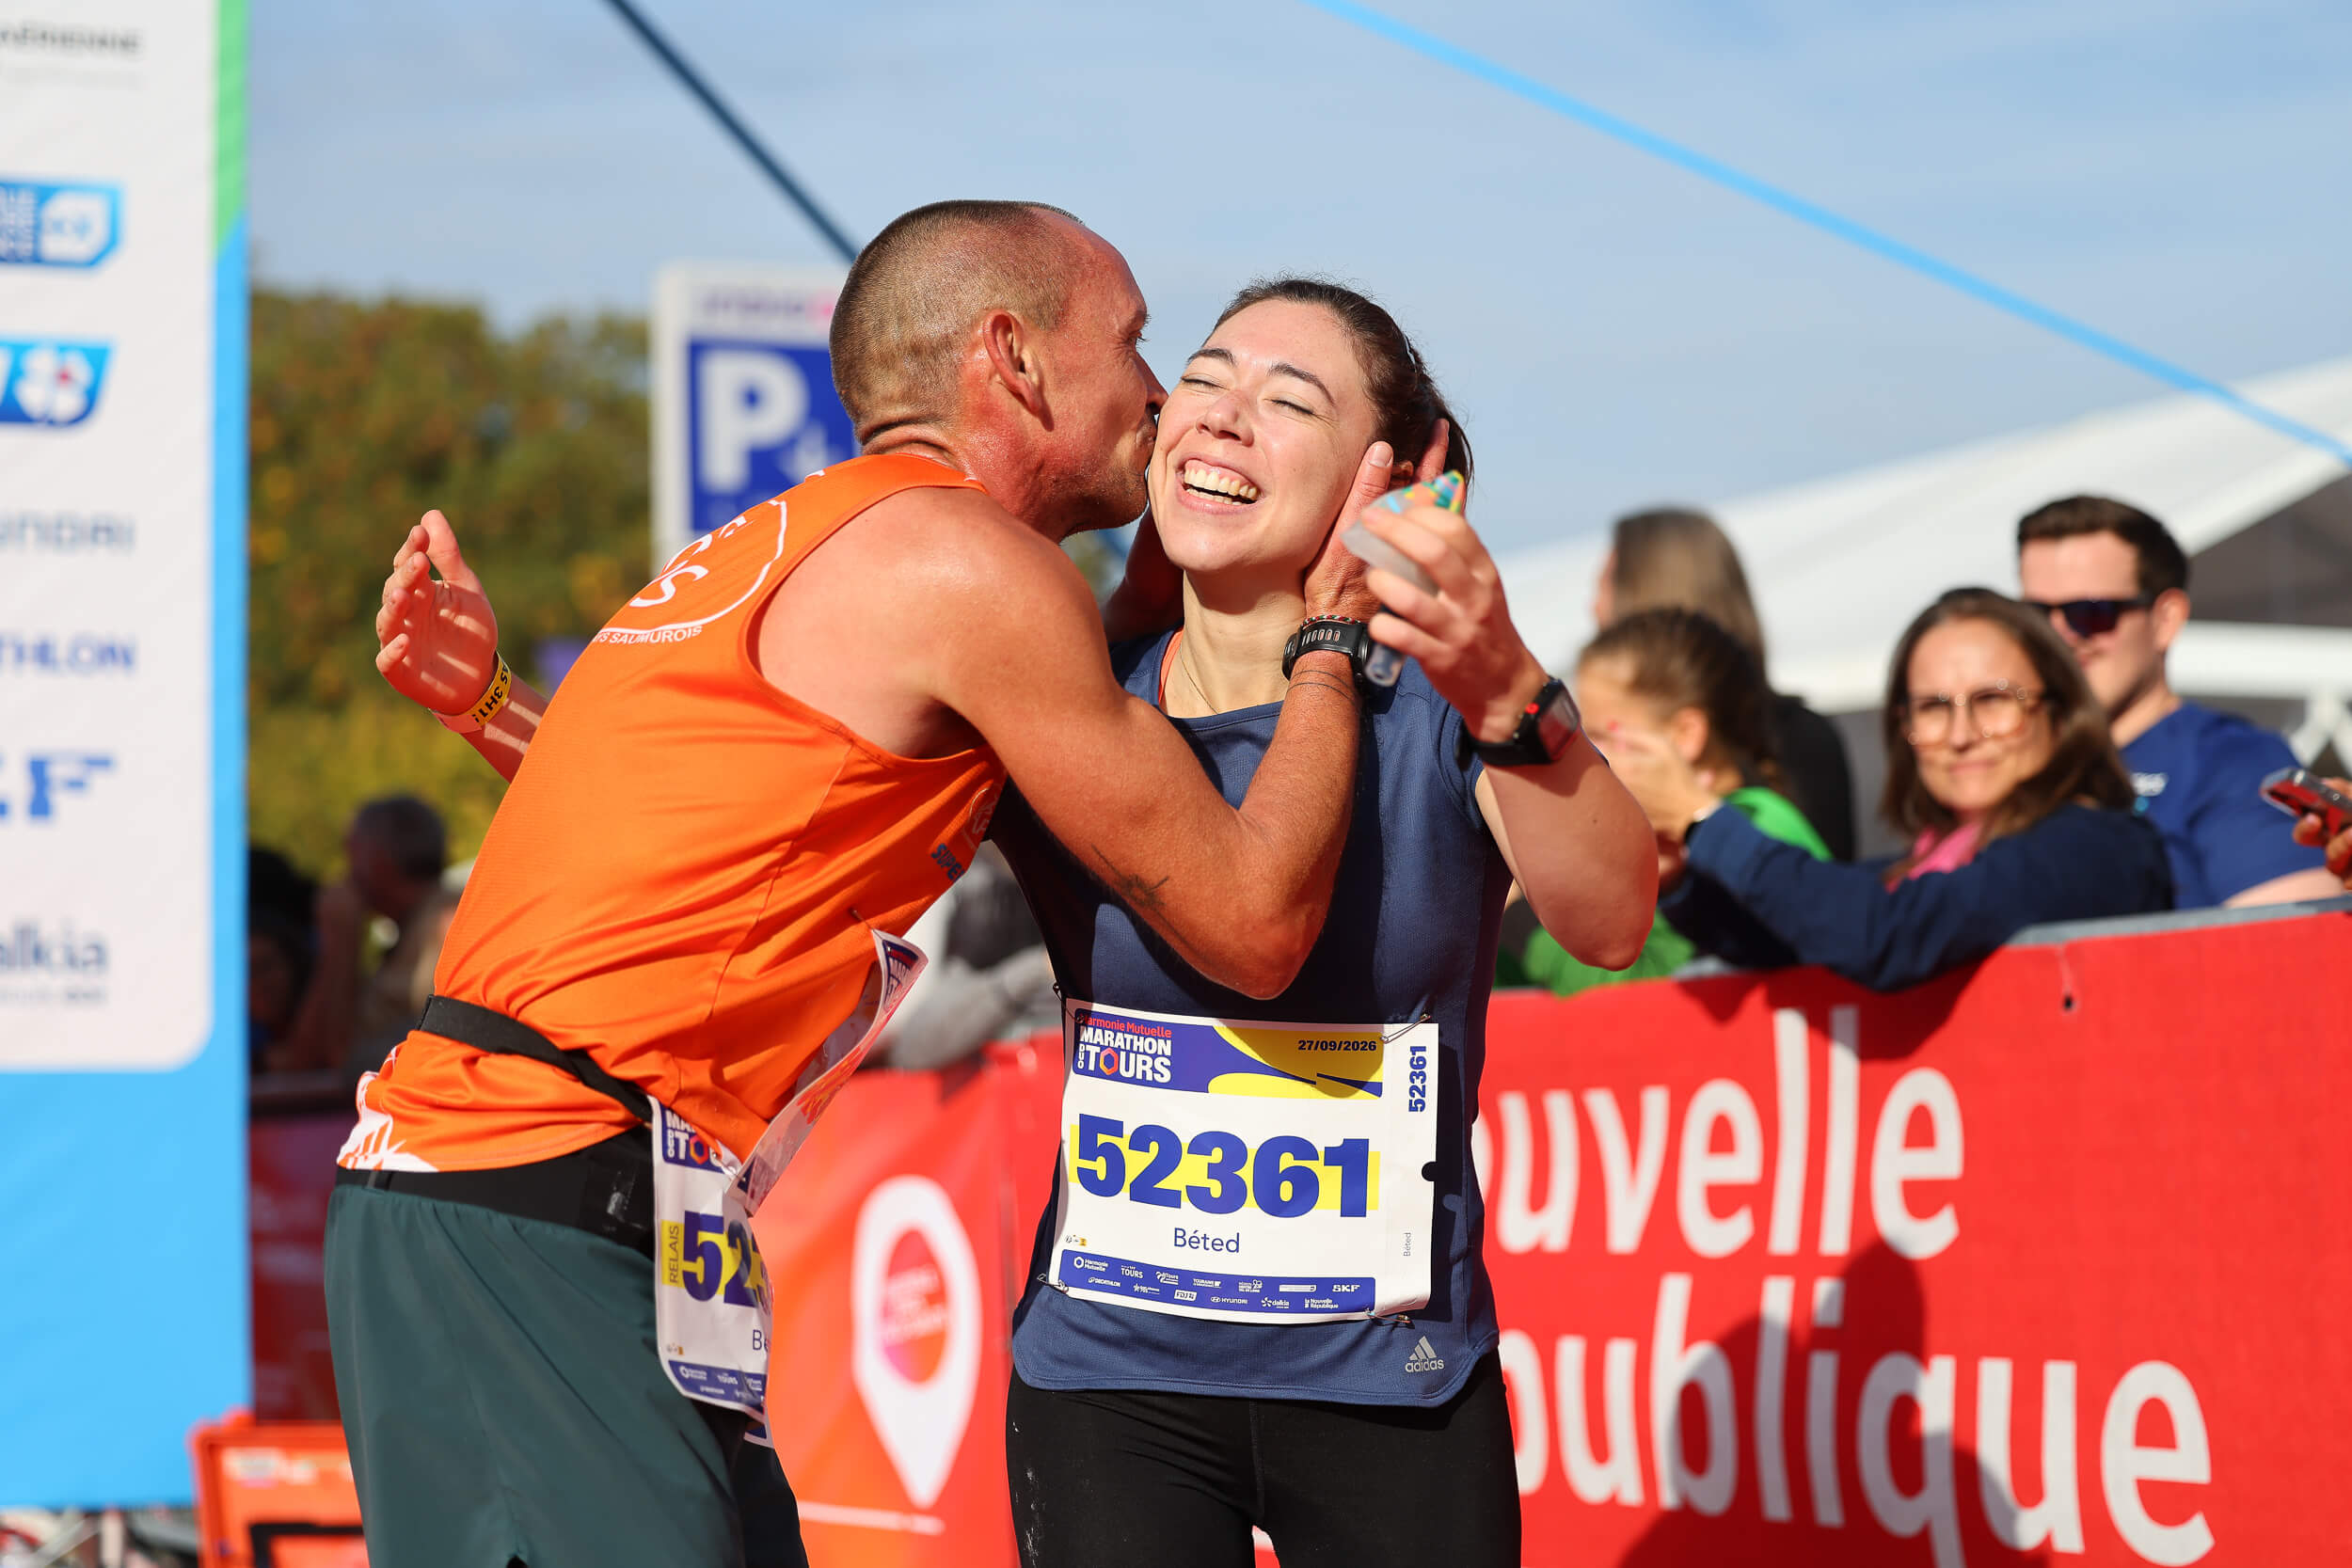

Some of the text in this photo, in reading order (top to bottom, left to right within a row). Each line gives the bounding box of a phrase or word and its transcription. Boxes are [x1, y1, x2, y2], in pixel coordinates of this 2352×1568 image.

[702, 352, 809, 492] P
[609, 626, 703, 644] SAUMUROIS
[1080, 1025, 1172, 1055] MARATHON
[1127, 1022, 1172, 1038] Mutuelle
[1298, 1039, 1376, 1052] 27/09/2026
[1085, 1044, 1171, 1084] TOURS
[1408, 1046, 1426, 1113] 52361
[665, 1109, 696, 1133] MA
[1471, 1003, 1964, 1259] uvelle
[1076, 1113, 1370, 1218] 52361
[669, 1225, 679, 1283] RELAIS
[1174, 1227, 1241, 1254] Béted
[682, 1211, 760, 1308] 52
[1121, 1268, 1144, 1279] TOURS
[1332, 1284, 1360, 1292] SKF
[1405, 1359, 1444, 1372] adidas
